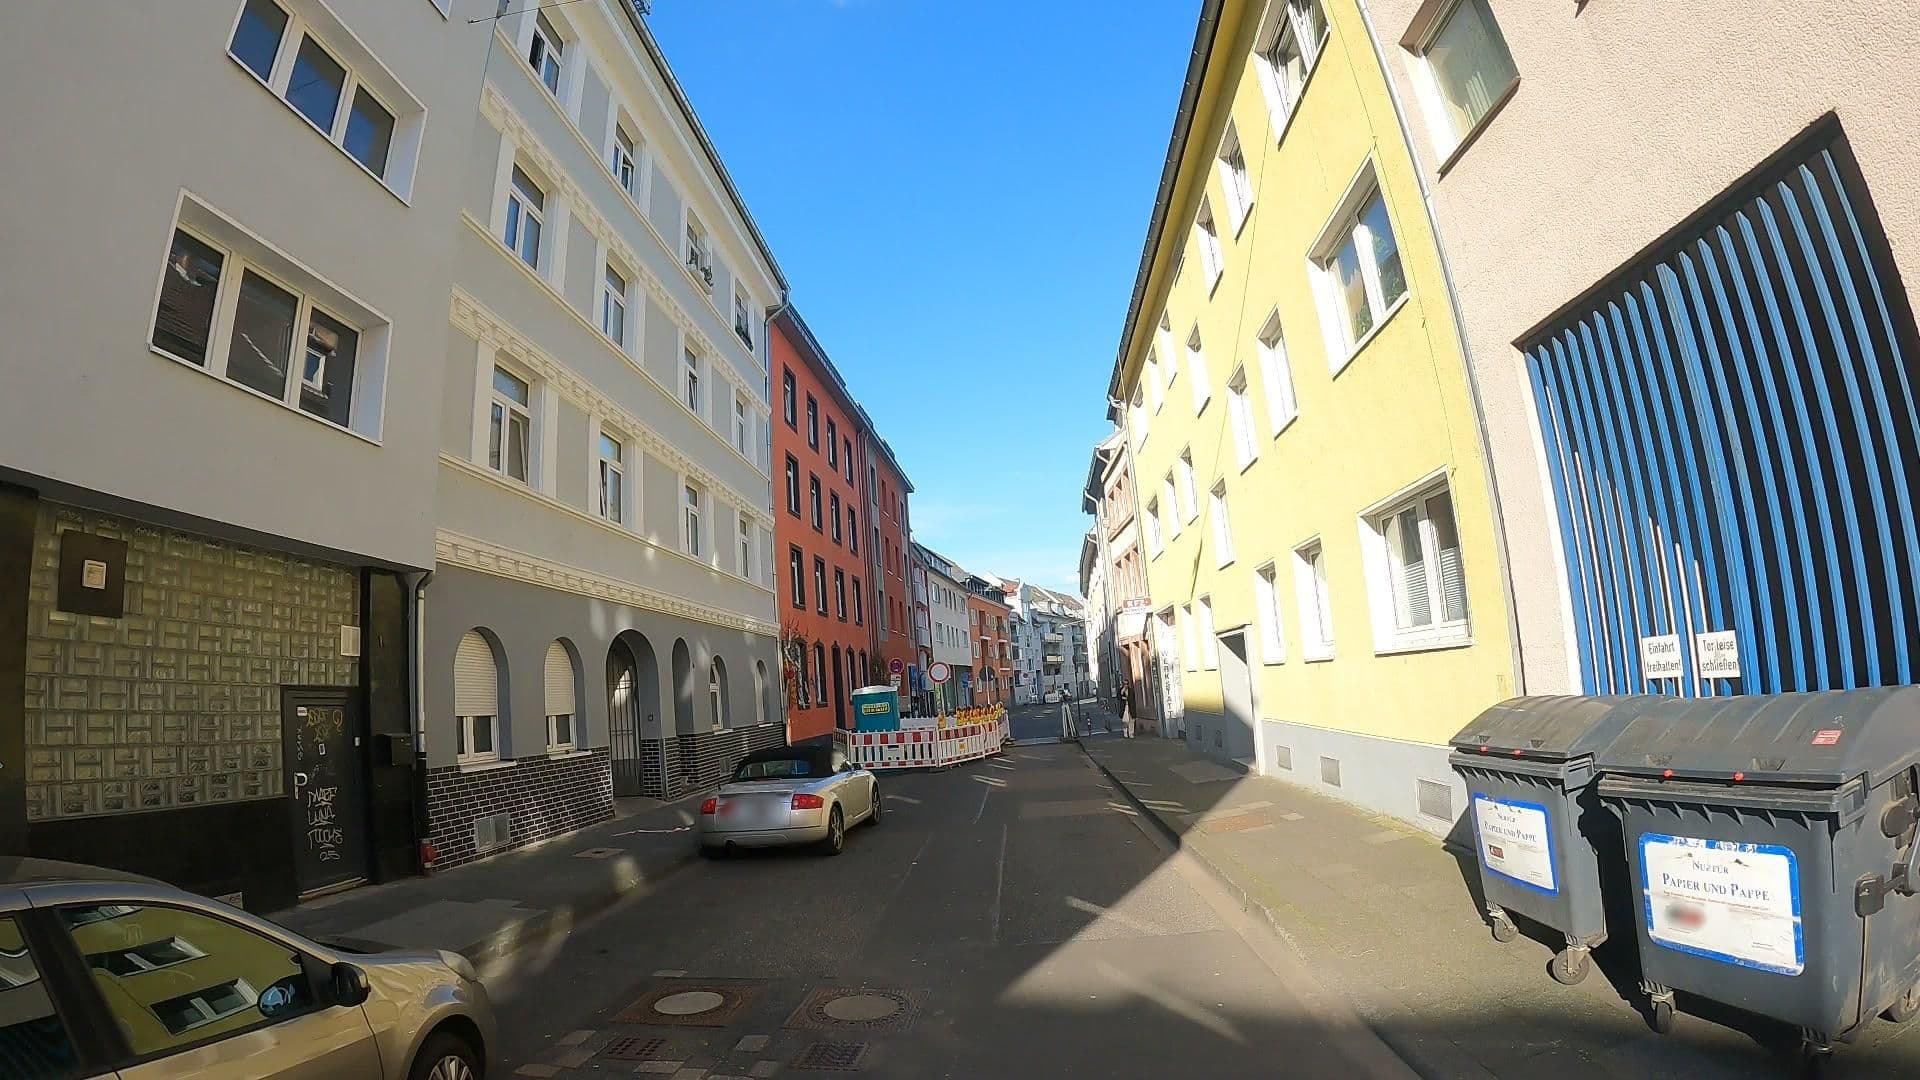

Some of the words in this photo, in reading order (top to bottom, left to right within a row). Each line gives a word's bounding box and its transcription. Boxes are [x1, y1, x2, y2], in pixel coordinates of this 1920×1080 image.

[1648, 641, 1675, 655] Einfahrt
[1702, 640, 1714, 652] Tor
[1716, 640, 1735, 651] leise
[1702, 659, 1737, 672] schließen
[1662, 872, 1700, 891] PAPIER
[1703, 882, 1726, 895] UND
[1730, 883, 1770, 901] PAPPE
